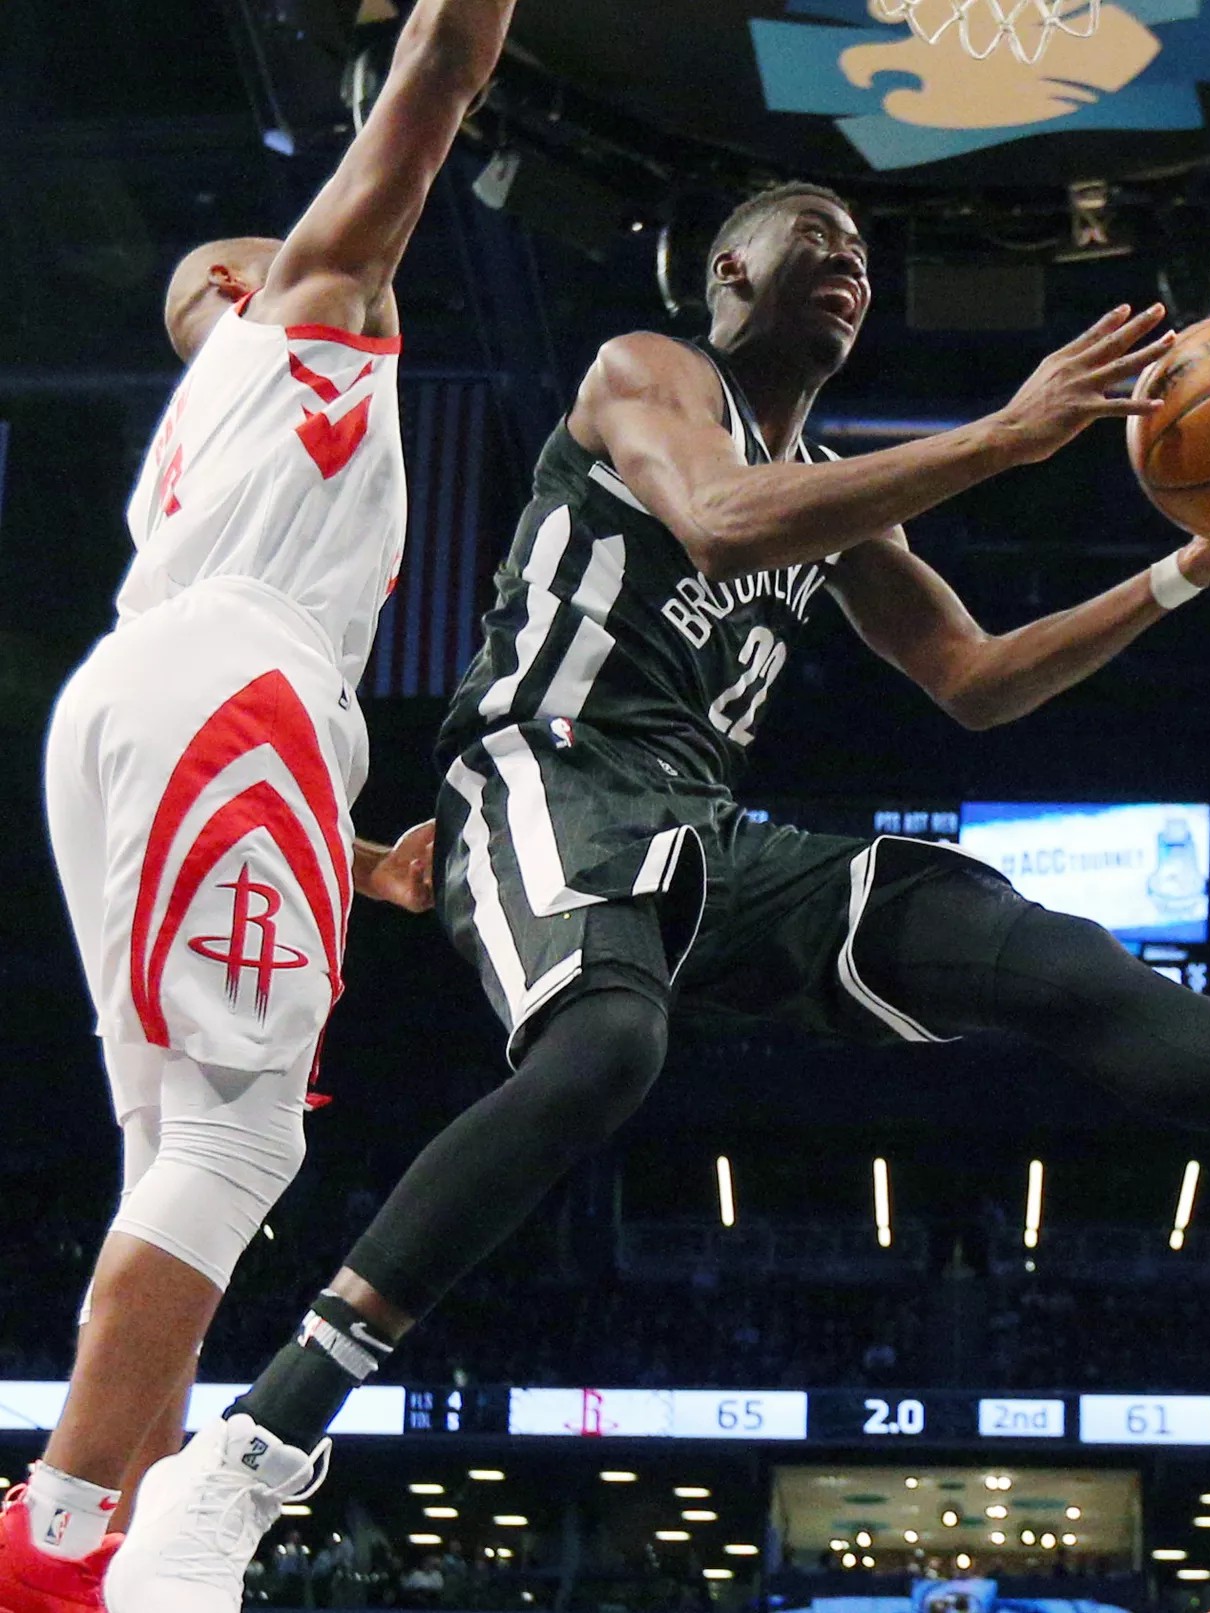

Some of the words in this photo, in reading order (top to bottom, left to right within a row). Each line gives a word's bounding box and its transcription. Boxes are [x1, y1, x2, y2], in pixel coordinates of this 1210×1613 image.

[708, 626, 787, 746] 22
[717, 1400, 764, 1430] 65
[863, 1399, 925, 1435] 2.0
[993, 1405, 1048, 1429] 2nd
[1127, 1405, 1170, 1434] 61
